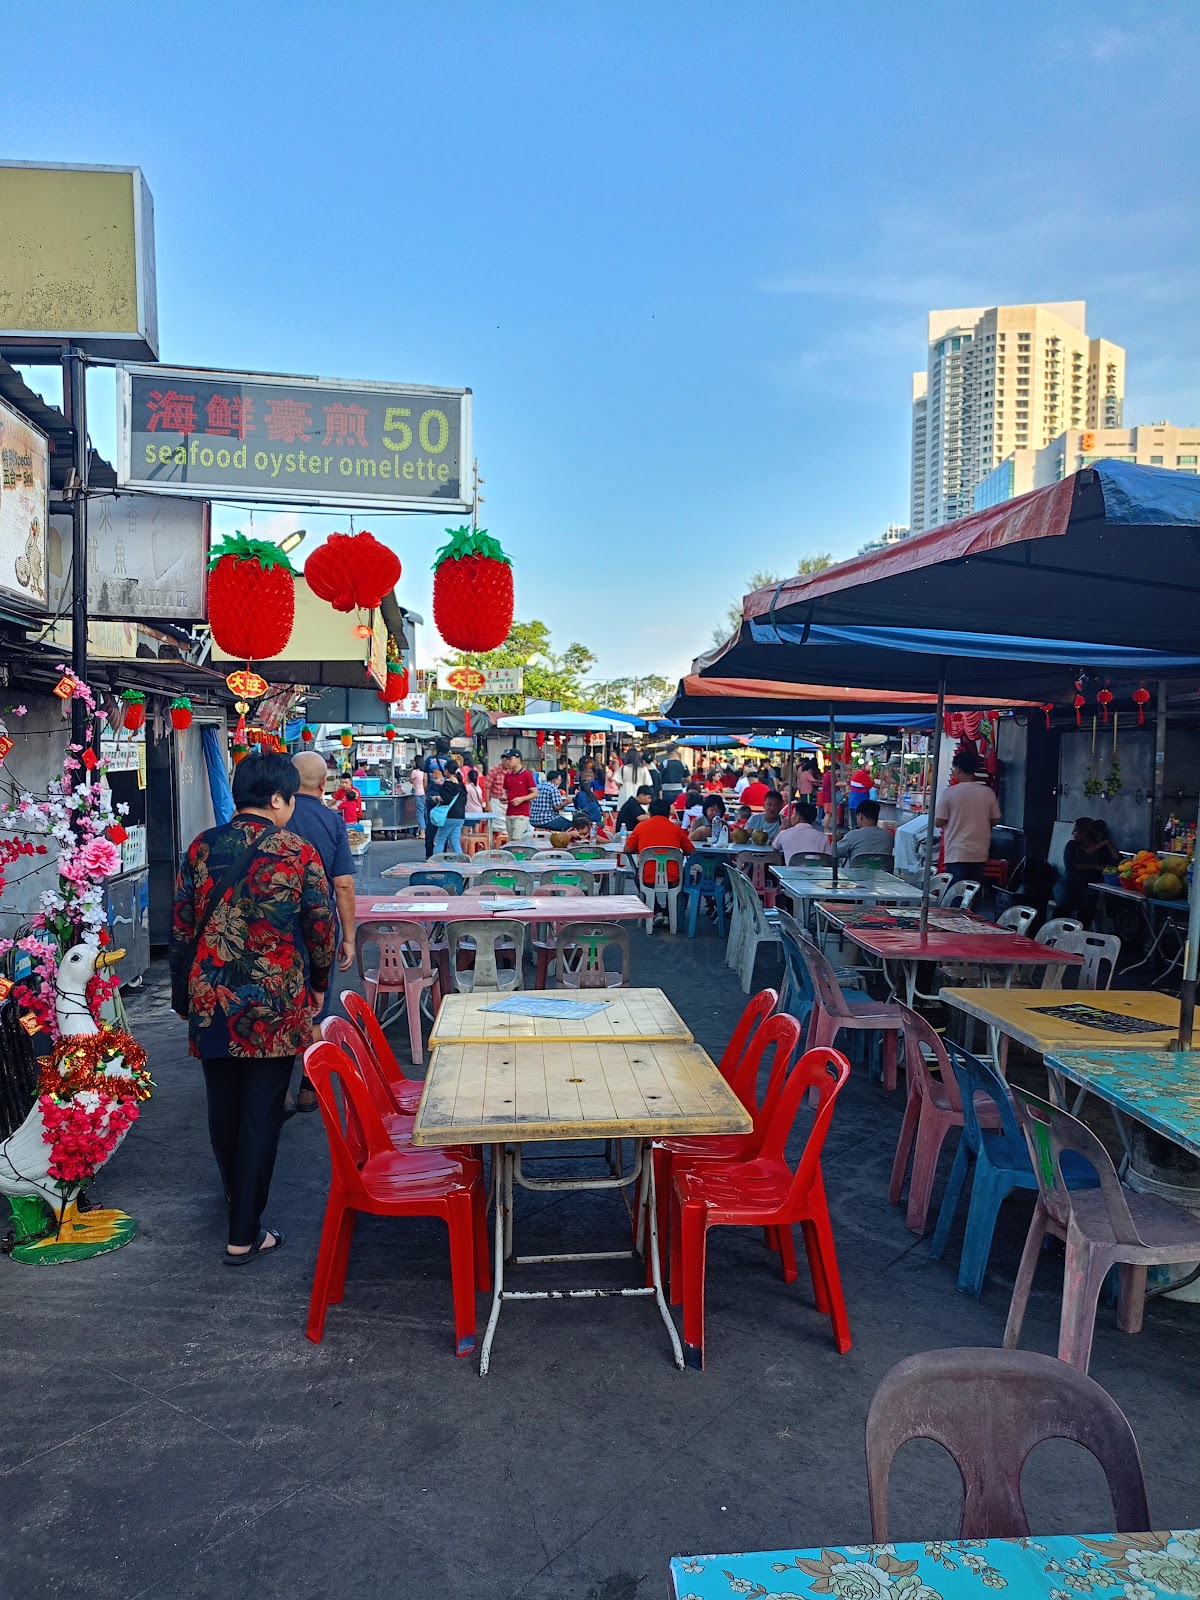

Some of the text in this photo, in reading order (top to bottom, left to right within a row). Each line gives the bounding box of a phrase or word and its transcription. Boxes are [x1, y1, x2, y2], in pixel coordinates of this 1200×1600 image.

[382, 407, 449, 454] 50
[145, 440, 449, 481] seafood oyster omelette
[230, 675, 263, 693] 大旺
[451, 672, 483, 687] 大旺
